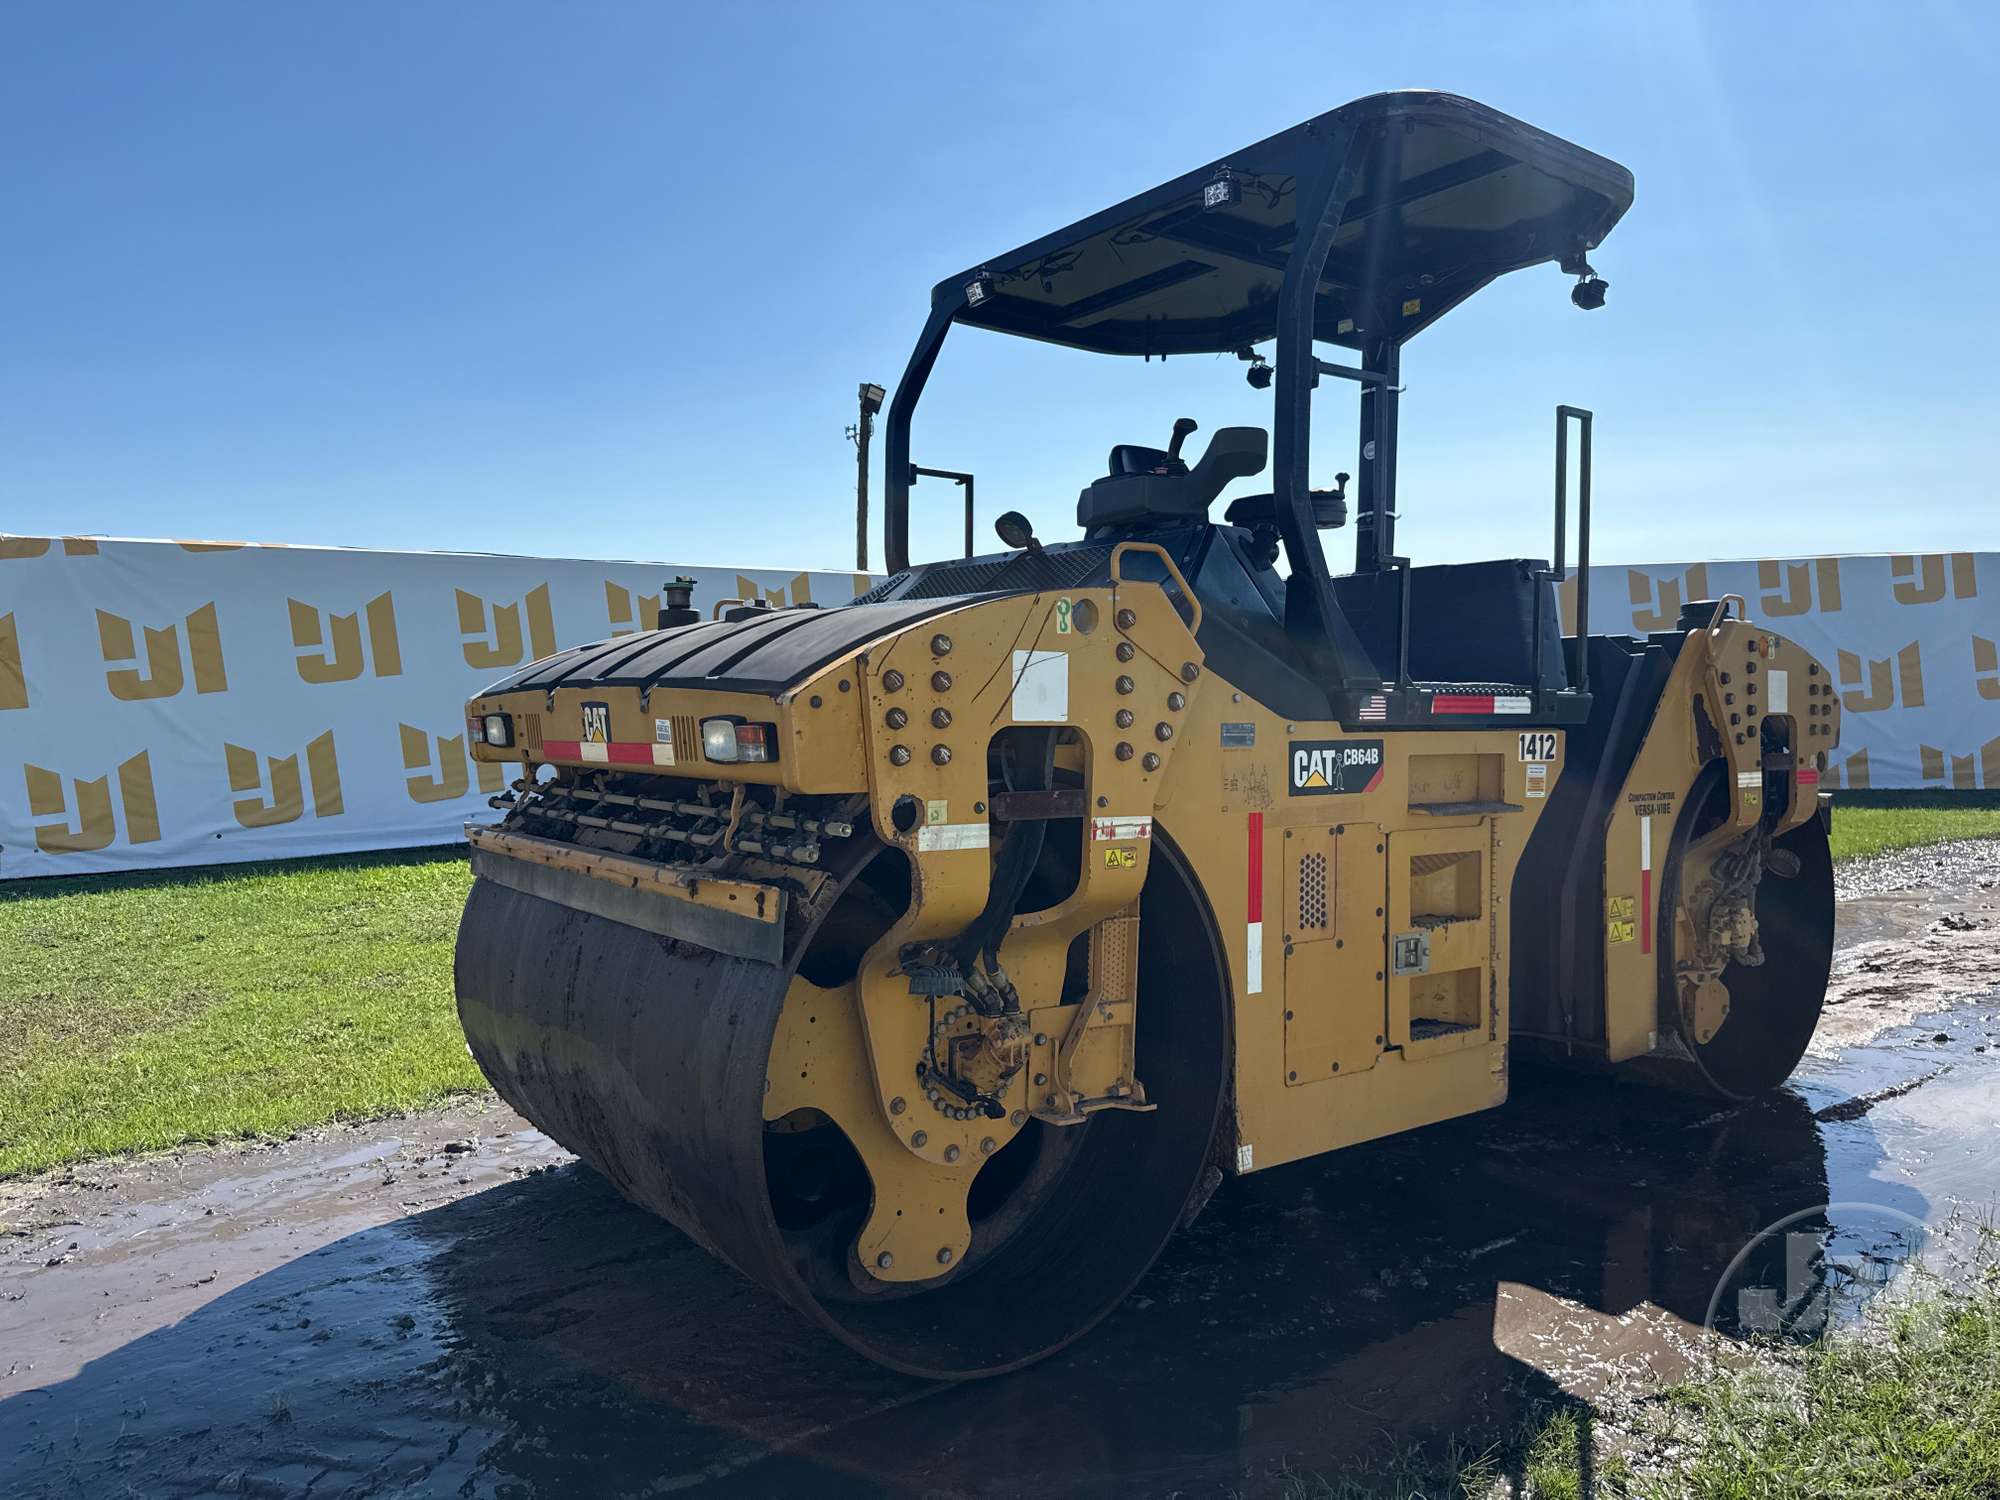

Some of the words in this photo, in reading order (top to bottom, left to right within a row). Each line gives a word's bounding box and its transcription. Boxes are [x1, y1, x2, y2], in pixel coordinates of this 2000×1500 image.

[584, 706, 608, 742] CAT
[1520, 734, 1555, 760] 1412
[1294, 749, 1336, 788] CAT
[1343, 748, 1379, 766] CB64B
